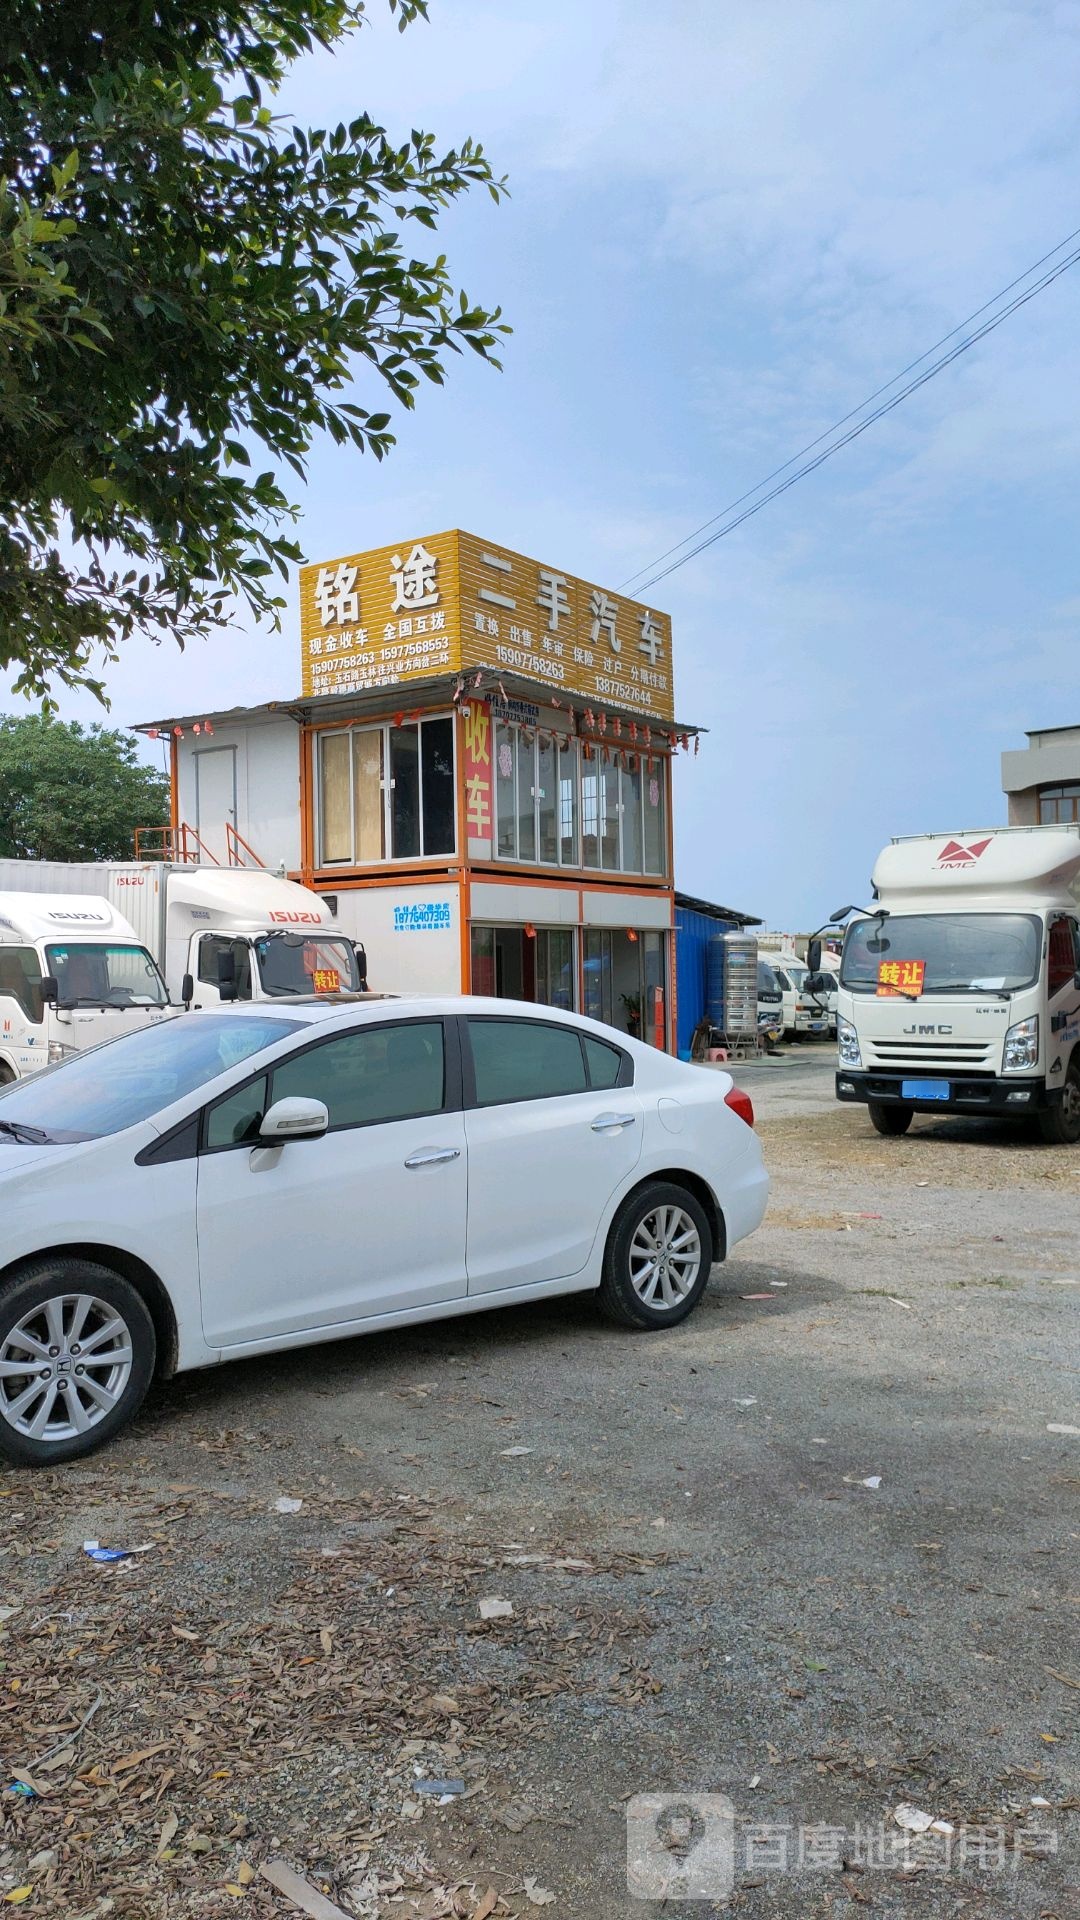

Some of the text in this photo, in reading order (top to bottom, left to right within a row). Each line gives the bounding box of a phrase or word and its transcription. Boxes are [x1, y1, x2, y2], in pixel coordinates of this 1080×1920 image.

[314, 544, 439, 627] 铭途
[477, 552, 666, 667] 二手汽车
[309, 628, 369, 656] 现金收车
[474, 612, 500, 638] 置换
[509, 625, 533, 648] 出售
[573, 646, 595, 667] 保险
[603, 656, 623, 675] 过户
[310, 636, 449, 675] 15907758263 15977568553
[495, 645, 565, 680] 15907758263
[594, 675, 652, 706] 13877527644
[465, 702, 491, 837] 收车
[931, 861, 977, 870] JMC
[117, 877, 144, 886] ISUZU
[48, 912, 104, 920] ISUZU
[269, 911, 321, 924] ISUZU
[395, 910, 450, 924] 18776407309
[314, 970, 338, 989] 转让
[879, 962, 922, 986] 转让
[903, 1025, 953, 1034] JMC
